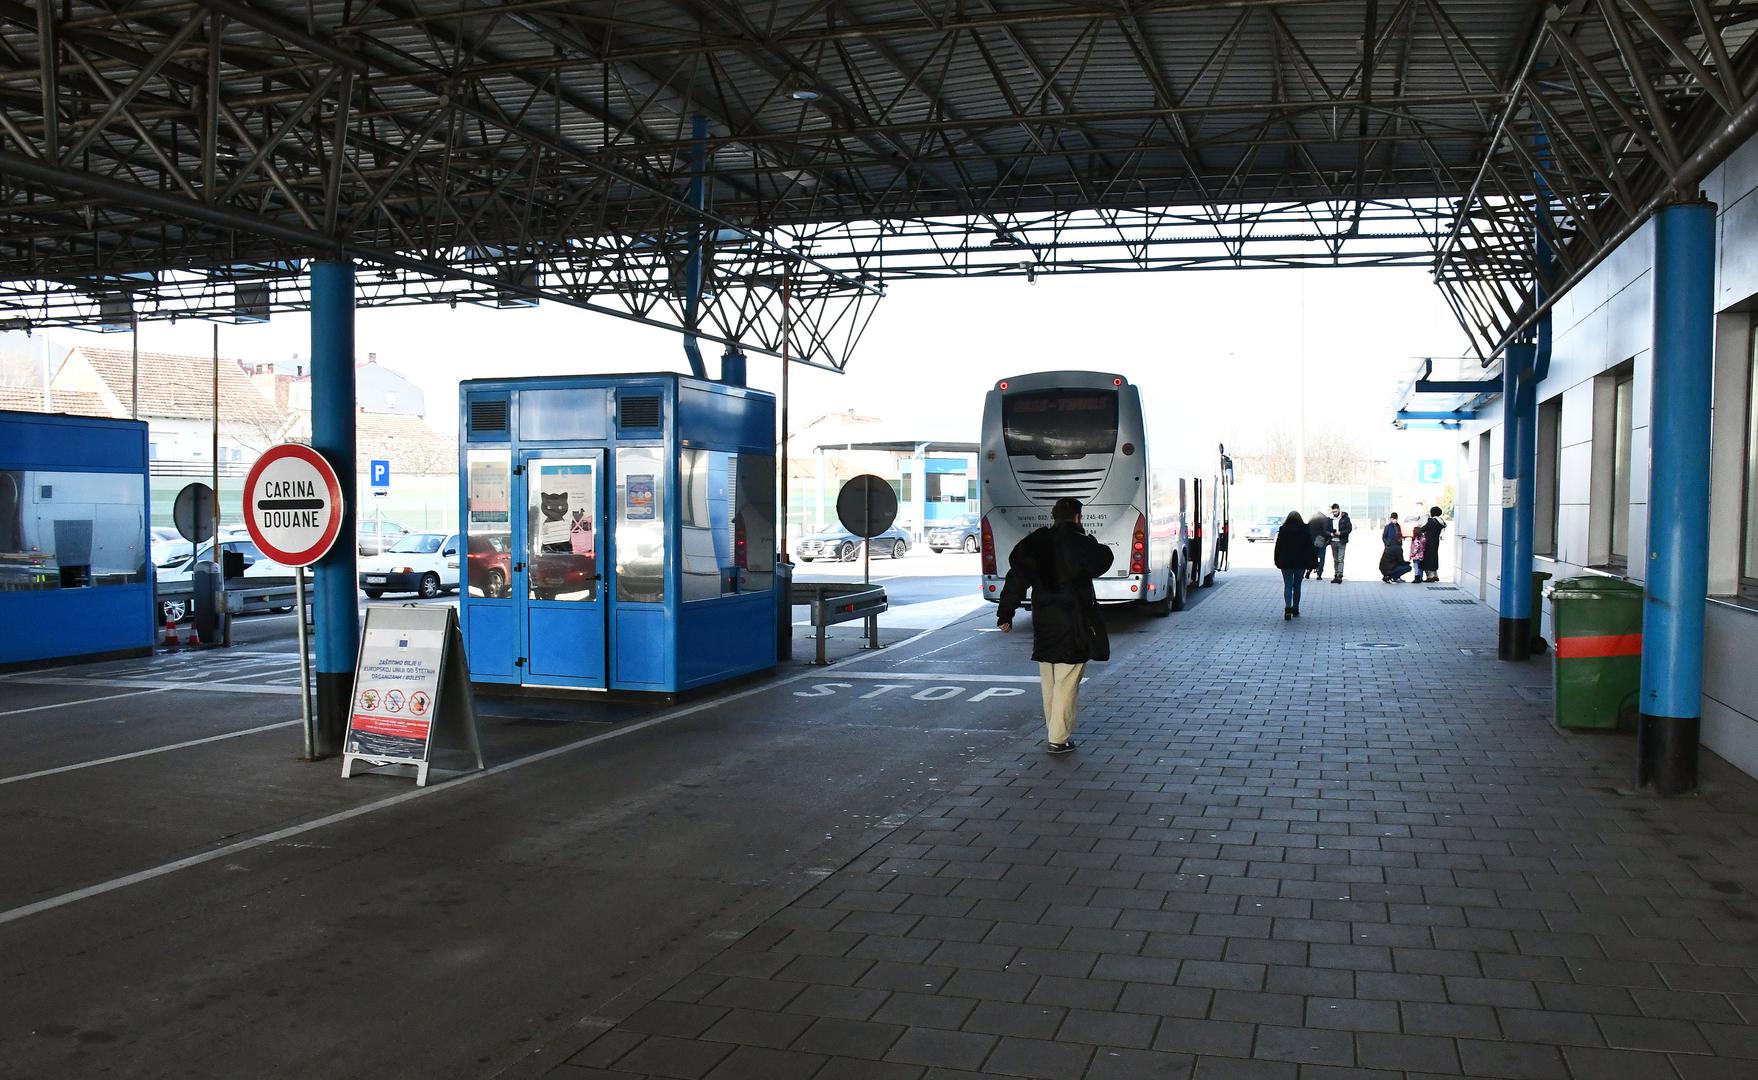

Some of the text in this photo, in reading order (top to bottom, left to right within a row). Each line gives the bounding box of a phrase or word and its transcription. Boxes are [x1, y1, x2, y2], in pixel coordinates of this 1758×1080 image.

[375, 465, 385, 482] P
[265, 480, 315, 498] CARINA
[264, 511, 320, 528] DOUANE
[793, 683, 1026, 702] STOP
